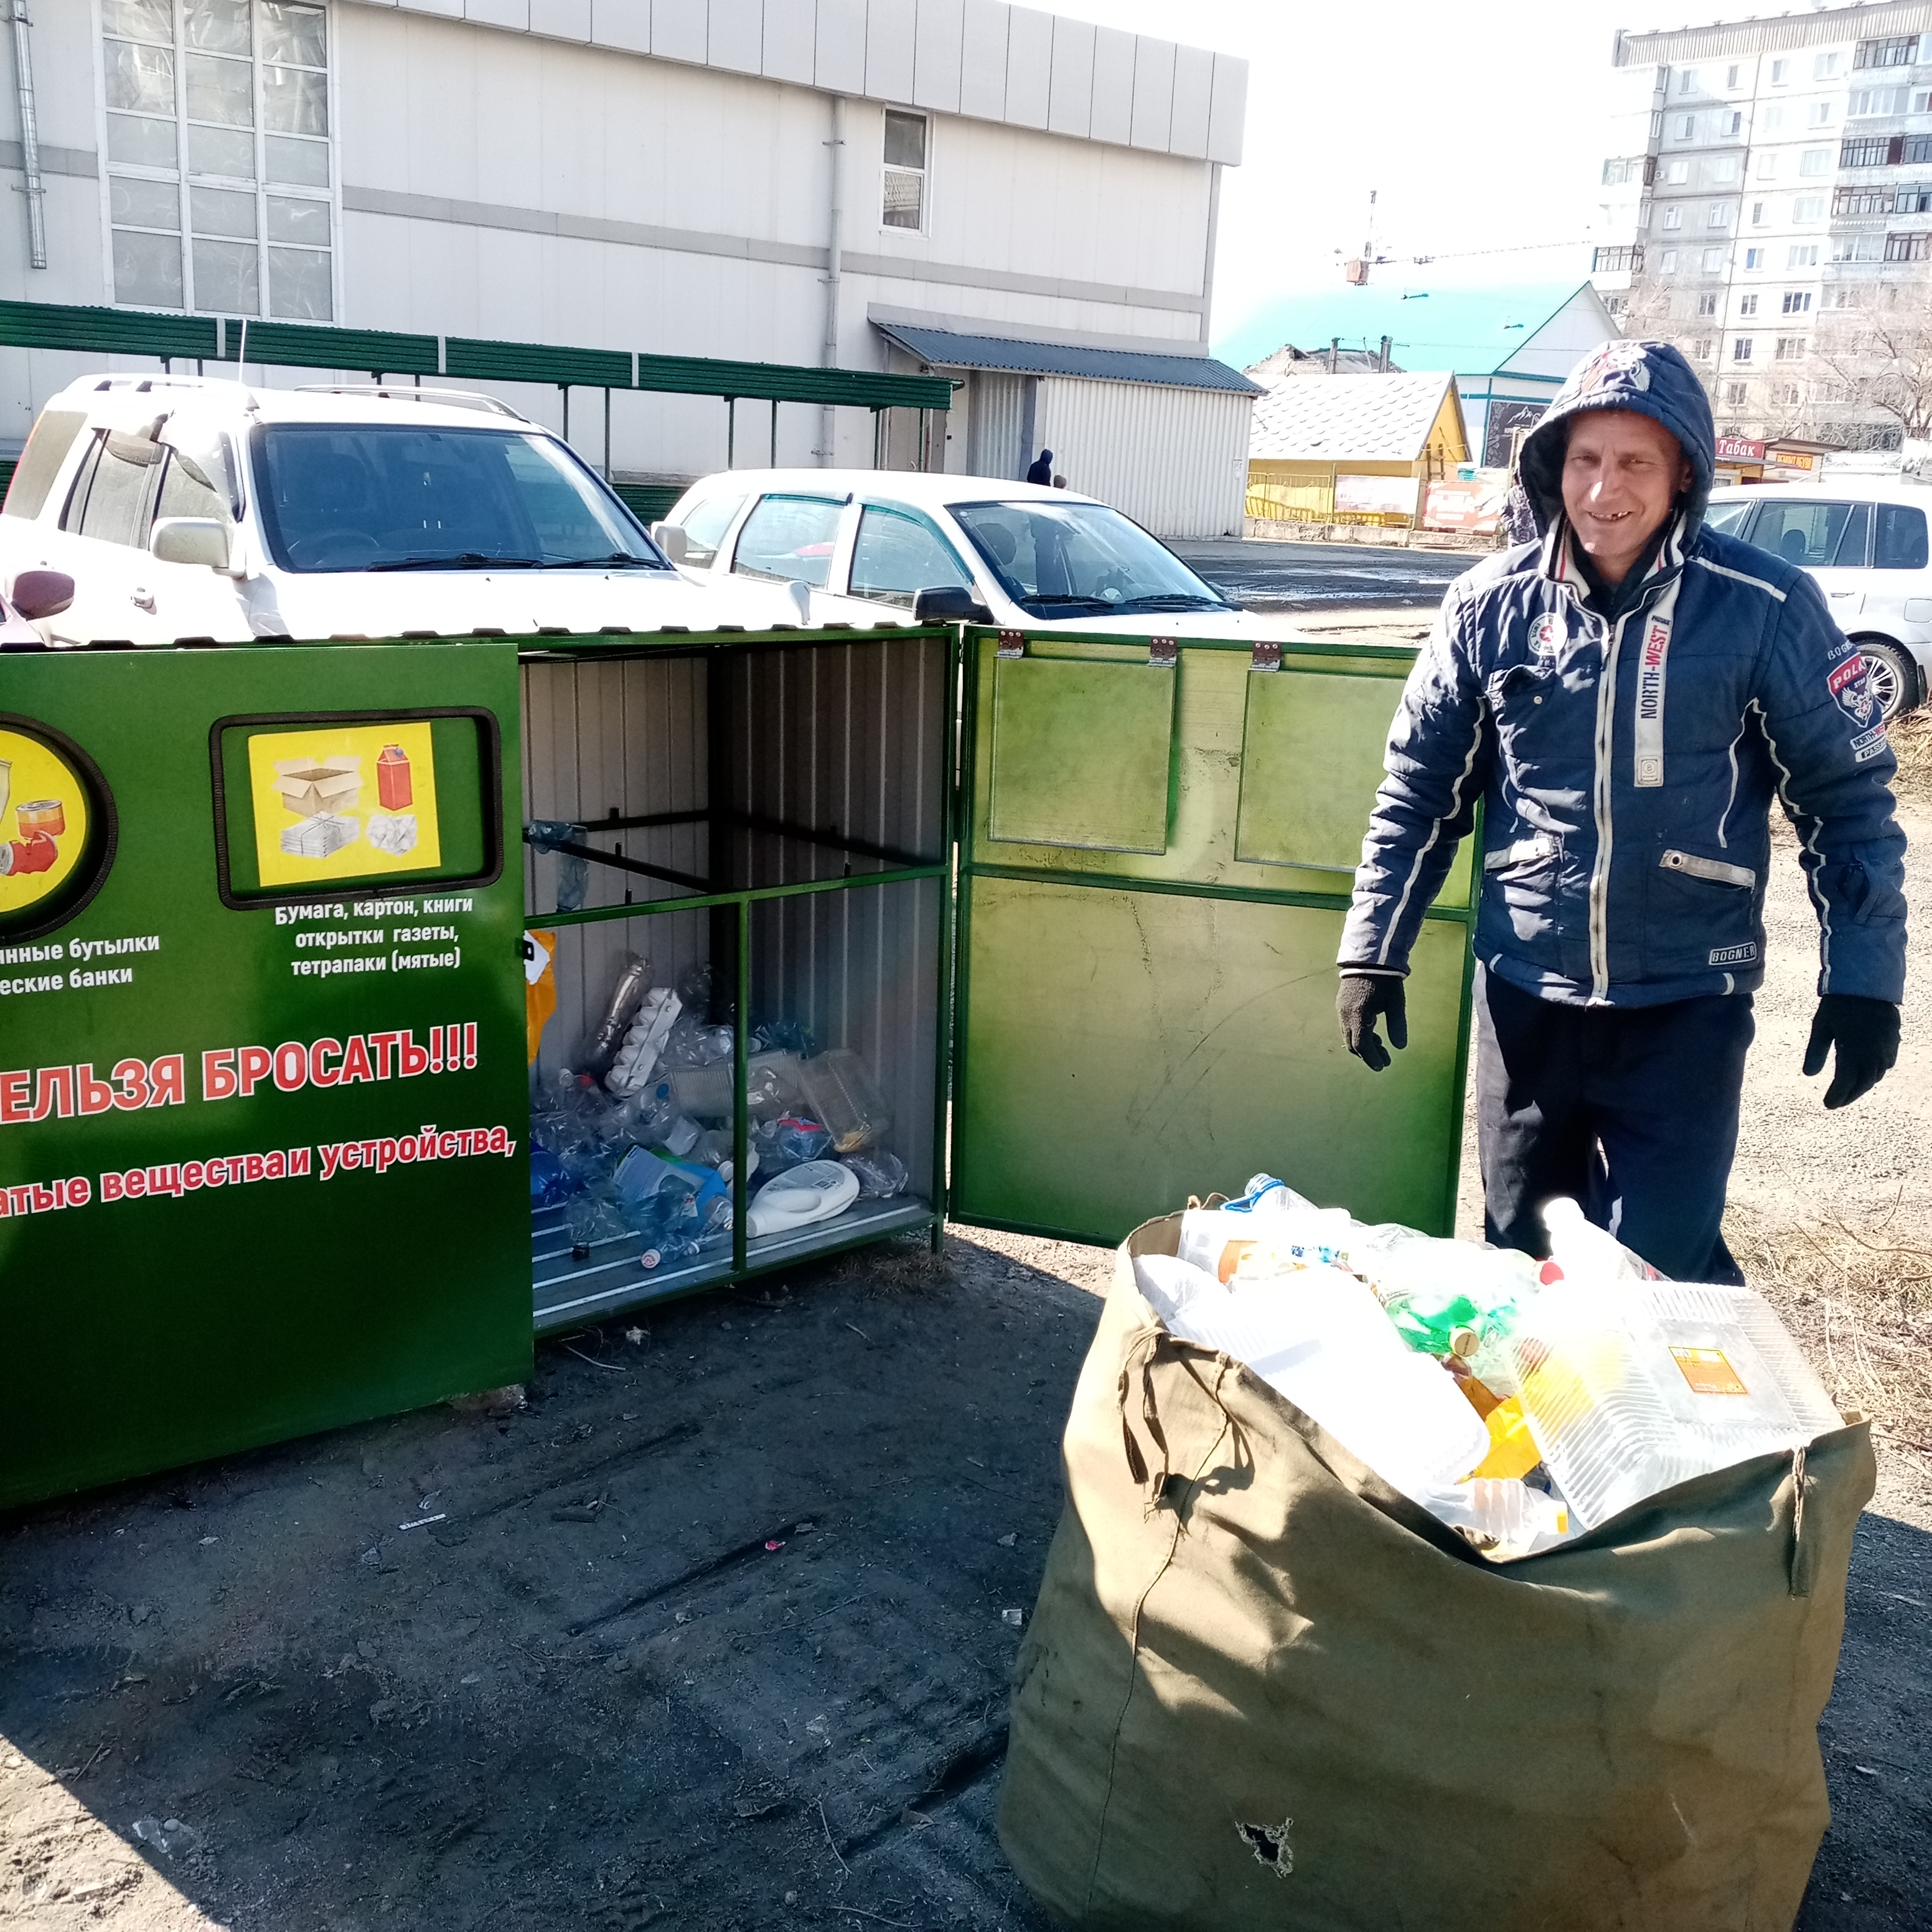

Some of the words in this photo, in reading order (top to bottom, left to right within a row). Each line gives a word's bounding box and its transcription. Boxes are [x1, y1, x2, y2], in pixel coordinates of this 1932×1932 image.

[1719, 439, 1756, 457] Табак
[1641, 624, 1668, 719] NORTH-WEST
[274, 903, 349, 926] Бумага,
[353, 900, 418, 920] картон,
[423, 898, 473, 914] книги
[69, 936, 159, 961] бутылки
[295, 929, 383, 950] открытки
[393, 926, 459, 942] газеты,
[291, 957, 386, 978] тетрапаки
[392, 946, 461, 972] (мятые)
[1712, 945, 1755, 962] BOGNER
[0, 974, 63, 995] еские
[69, 968, 133, 988] банки
[202, 1021, 477, 1101] БРОСАТЬ!!!
[317, 1124, 517, 1181] устройства,
